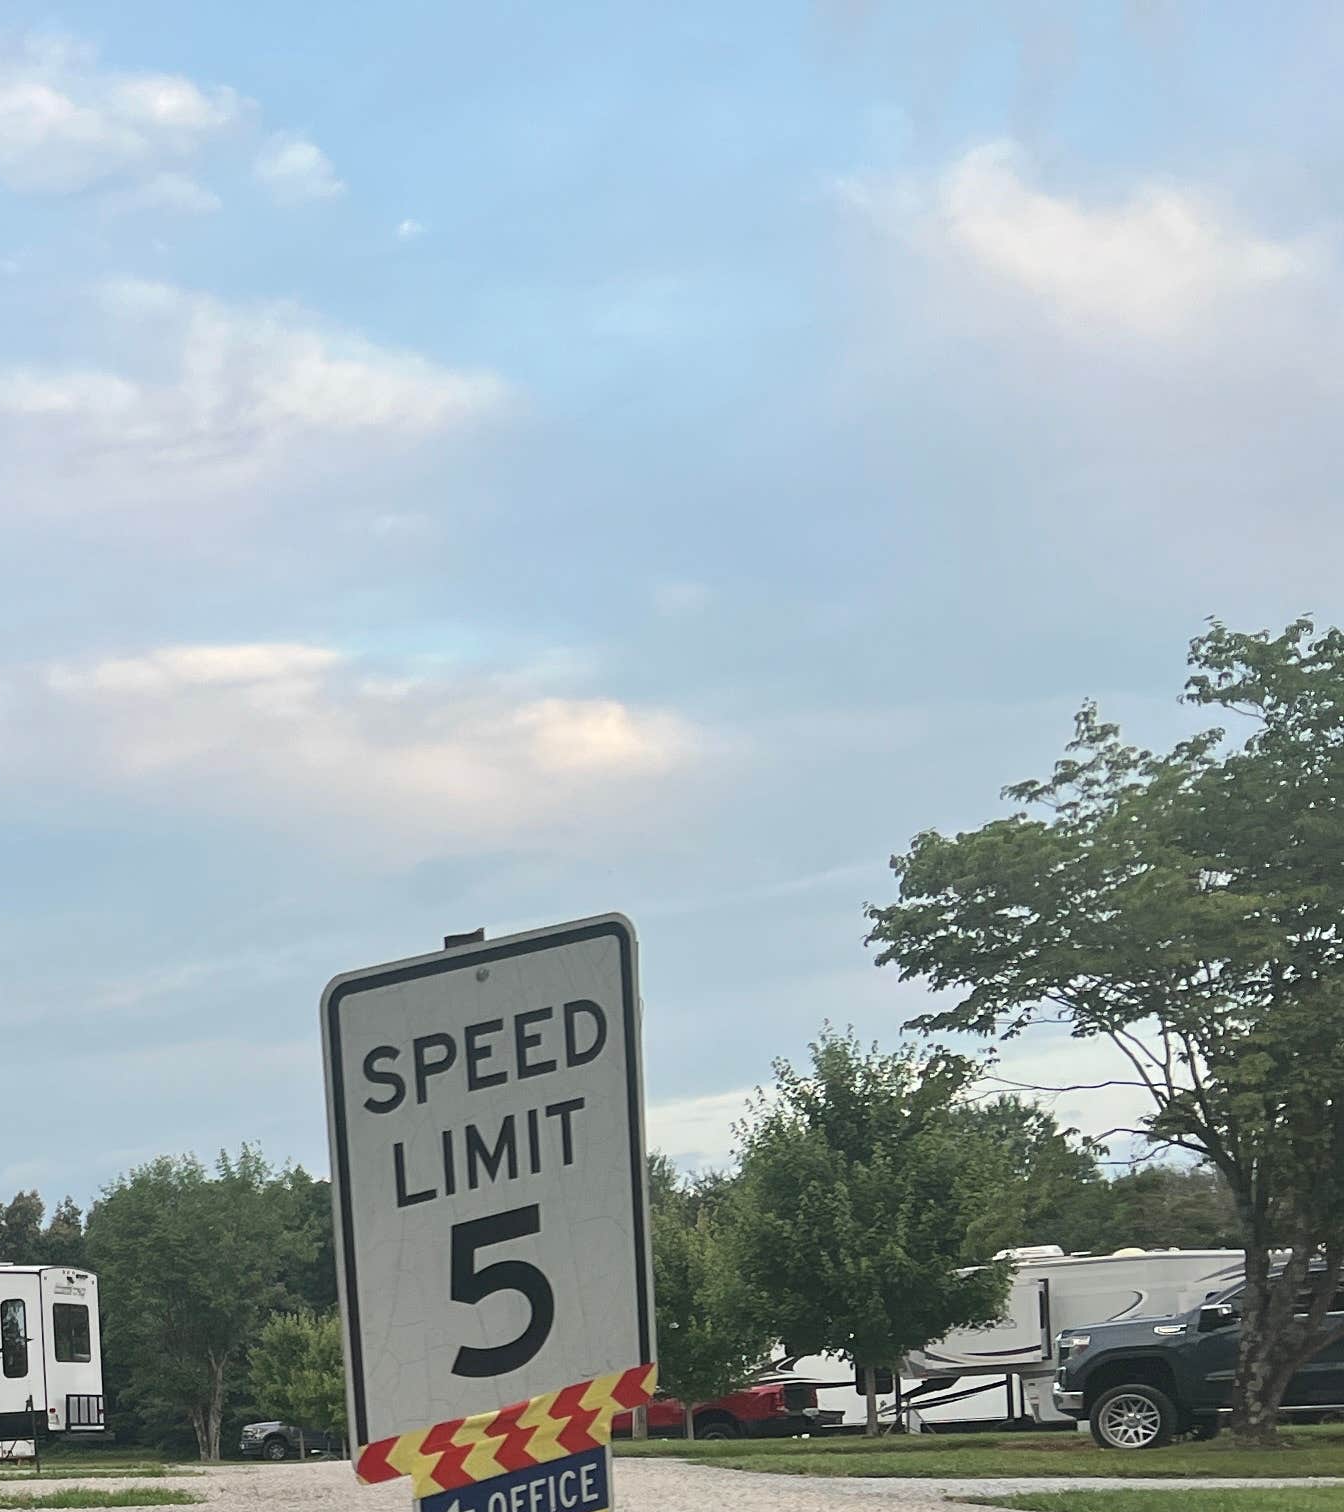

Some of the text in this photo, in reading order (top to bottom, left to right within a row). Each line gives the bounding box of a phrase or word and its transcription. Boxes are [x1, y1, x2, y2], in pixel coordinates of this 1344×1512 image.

[362, 998, 608, 1115] SPEED
[393, 1097, 586, 1208] LIMIT
[450, 1202, 555, 1379] 5
